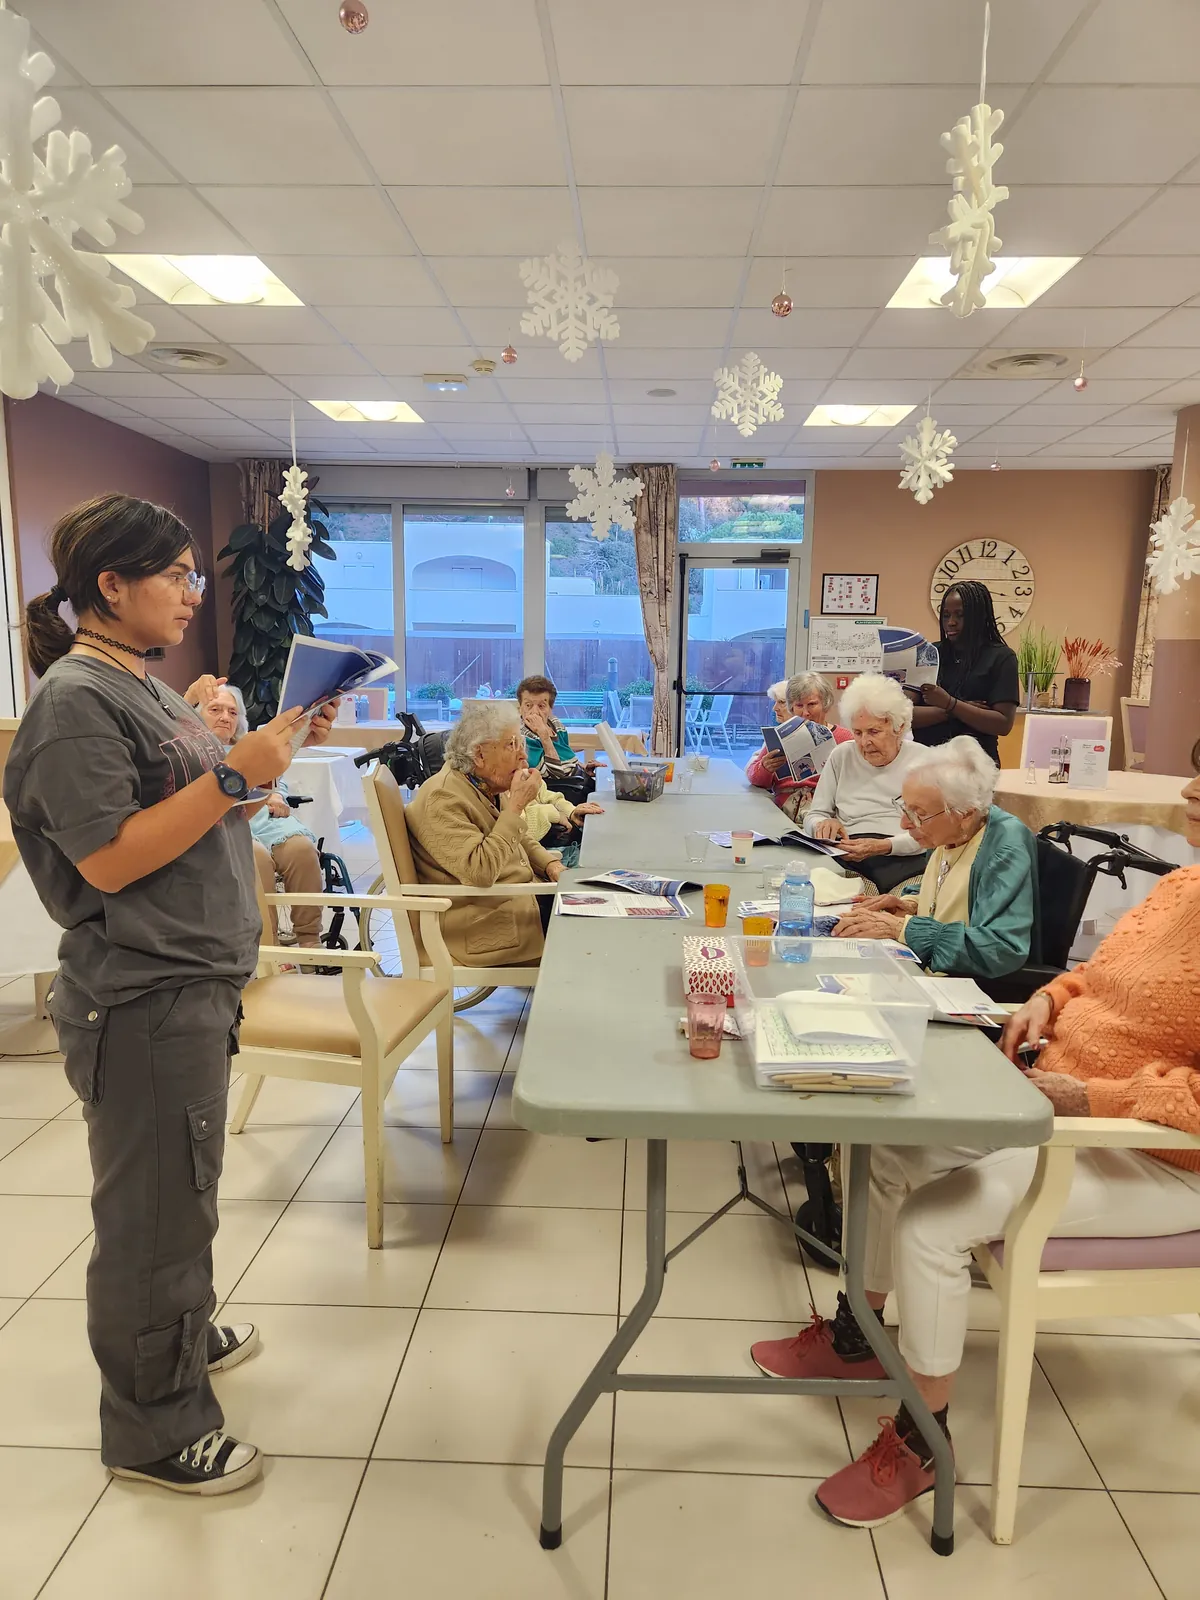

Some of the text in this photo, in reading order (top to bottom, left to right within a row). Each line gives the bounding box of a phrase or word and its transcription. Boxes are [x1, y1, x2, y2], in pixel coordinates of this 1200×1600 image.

[956, 545, 975, 566] 11
[979, 540, 998, 558] 12
[1002, 550, 1016, 566] 1
[938, 559, 960, 580] 10
[1012, 565, 1030, 579] 2
[934, 583, 950, 594] 9
[1014, 586, 1032, 597] 3
[1008, 606, 1025, 619] 4
